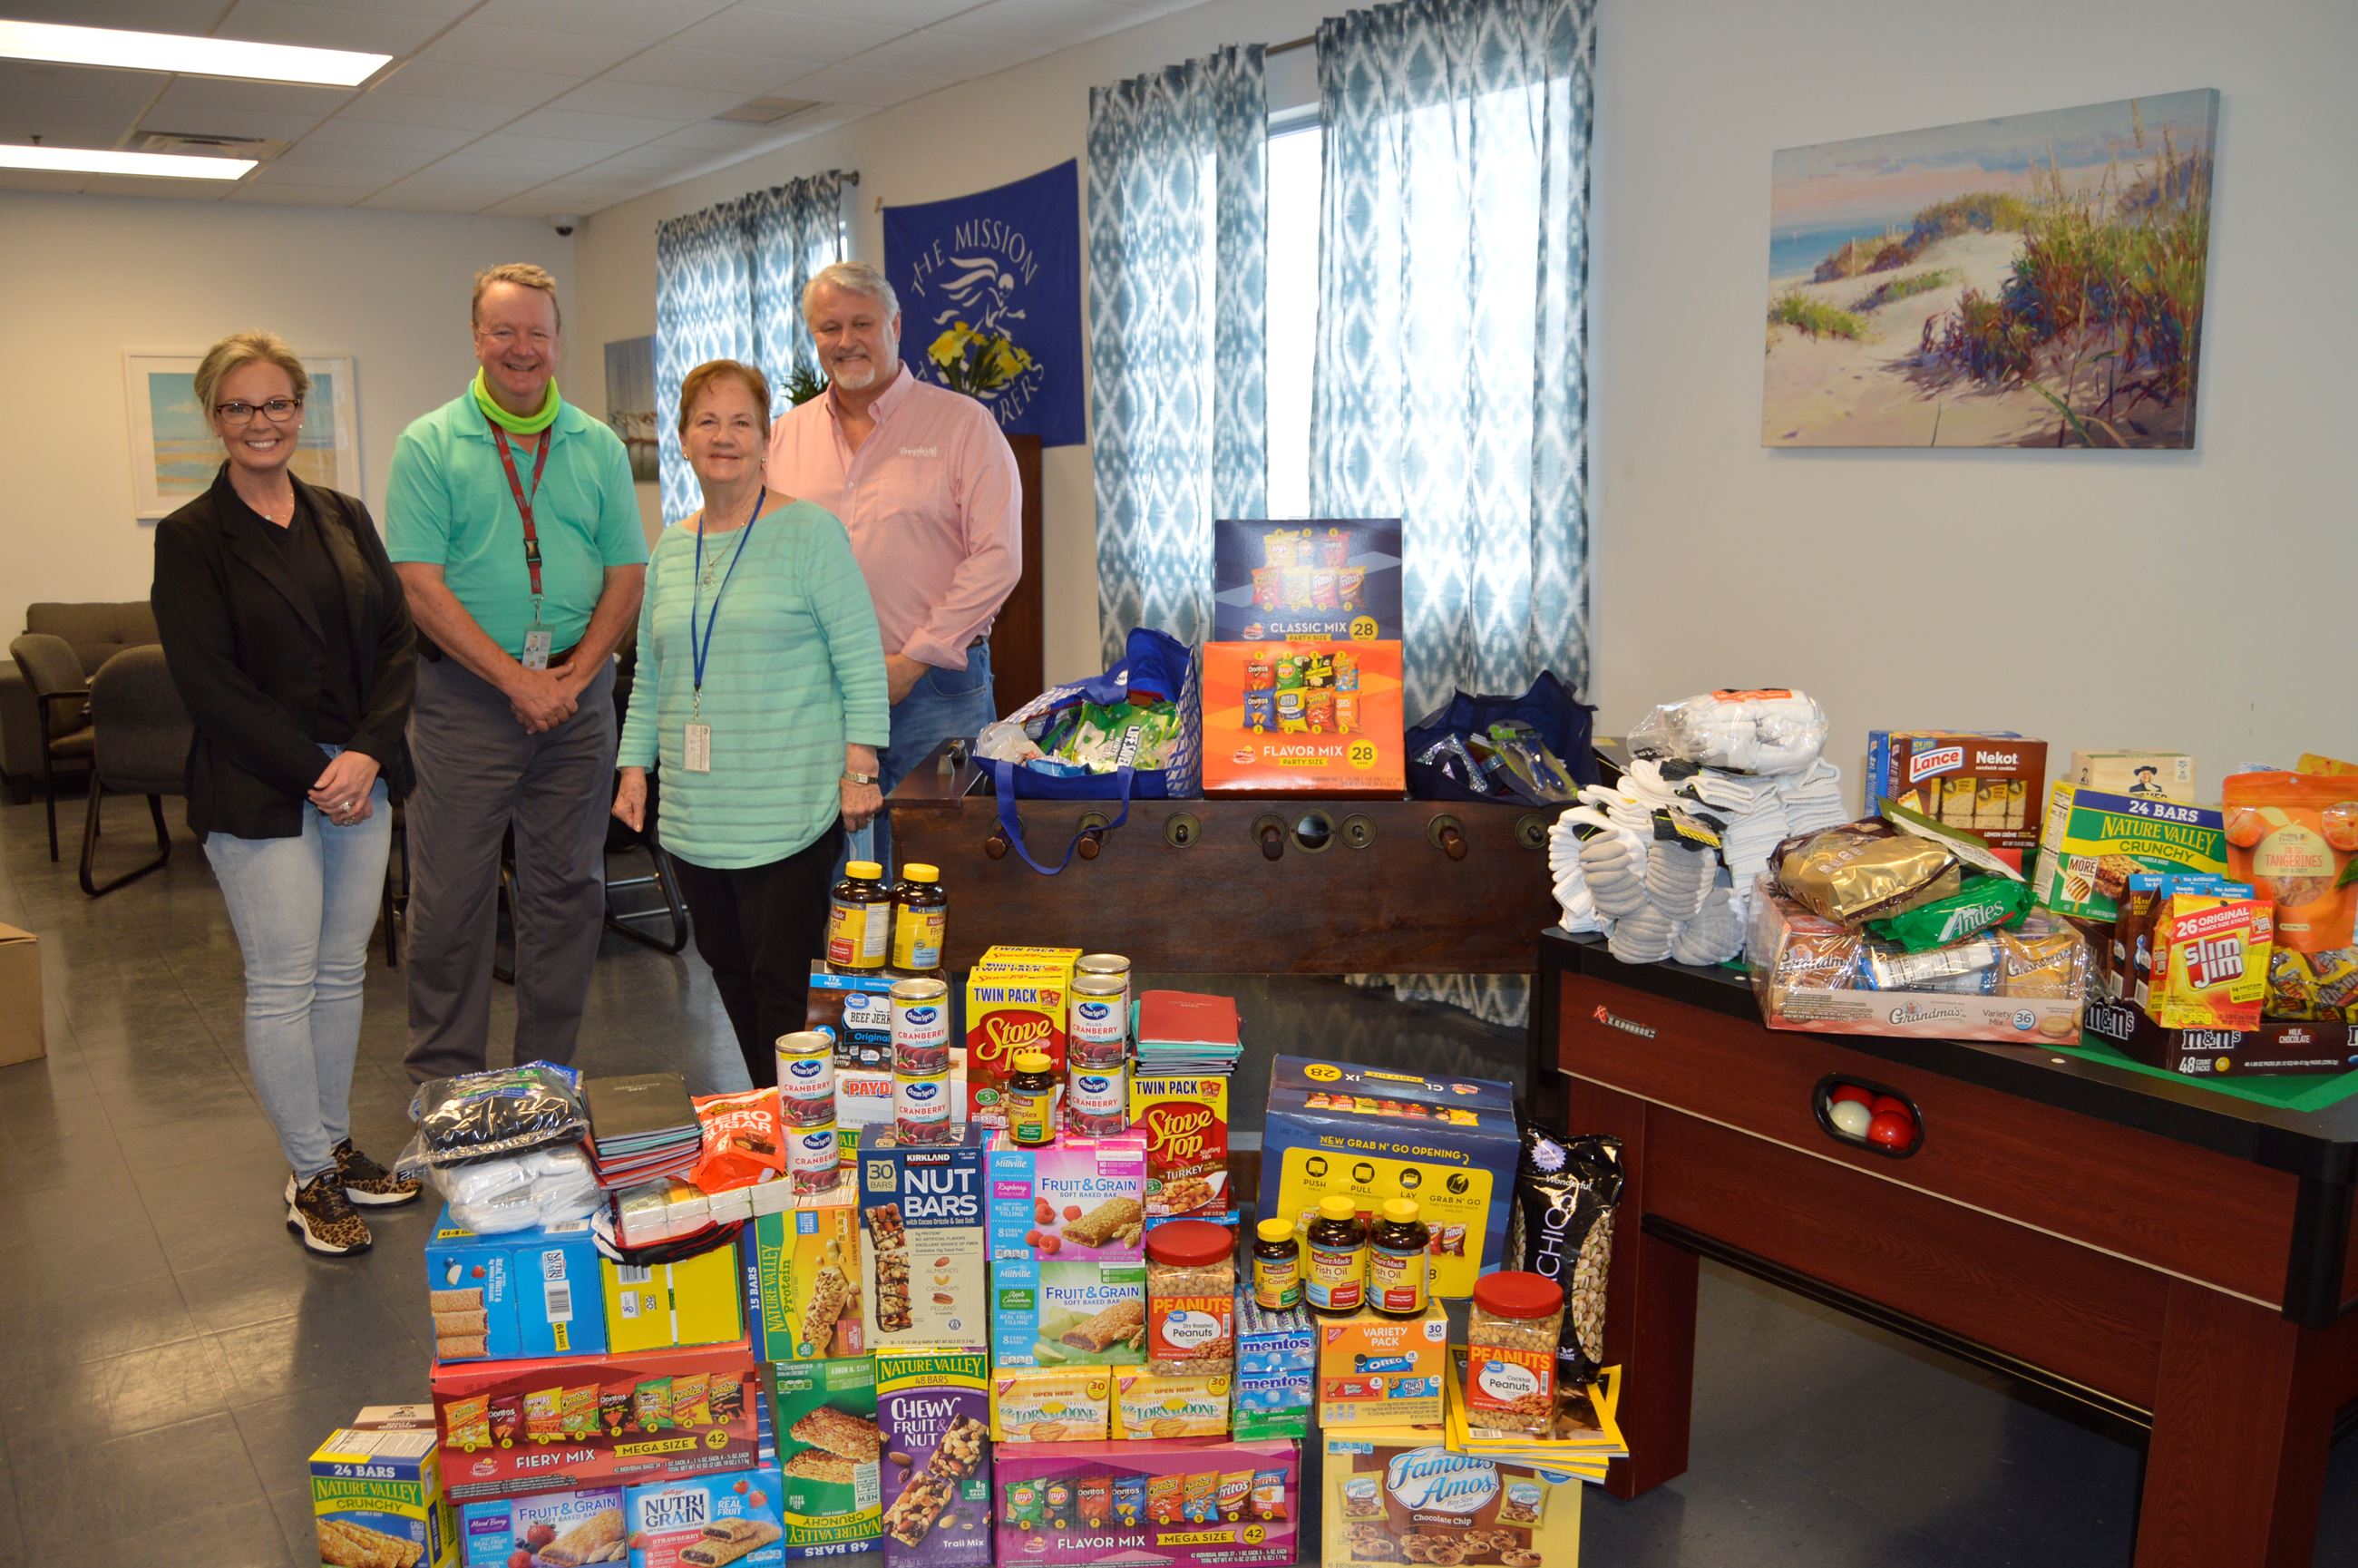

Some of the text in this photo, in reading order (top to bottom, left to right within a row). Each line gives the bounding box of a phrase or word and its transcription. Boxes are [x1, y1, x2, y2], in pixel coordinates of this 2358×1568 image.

[911, 218, 1039, 298] THE MISSION
[1270, 622, 1348, 633] CLASSIC MIX
[1353, 623, 1374, 637] 28
[1262, 745, 1343, 756] FLAVOR MIX
[1351, 746, 1373, 760] 28
[1975, 750, 2018, 765] Nekot
[1913, 750, 1960, 773] Lance
[2129, 800, 2198, 823] 24 BARS
[2100, 815, 2218, 856] NATURE VALLEY
[2119, 841, 2195, 862] CRUNCHY
[2069, 859, 2096, 873] MORE
[2265, 855, 2323, 868] TANGERINES
[1947, 901, 2004, 940] Andes
[2176, 907, 2250, 938] 26 ORIGINAL
[2184, 938, 2242, 967] slim
[2195, 955, 2244, 989] Jim
[973, 988, 1038, 1003] TWIN PACK
[850, 1013, 870, 1024] BEEF
[1889, 1006, 1962, 1026] Grandma's
[1983, 1008, 2012, 1019] Variety
[2015, 1012, 2032, 1024] 36
[1988, 1017, 2004, 1027] Mix
[898, 1028, 945, 1039] CRANBERRY
[1073, 1025, 1118, 1035] CRANBERRY
[2287, 1028, 2302, 1037] MILK
[854, 1033, 891, 1043] Original
[976, 1017, 1053, 1061] Stove
[2278, 1035, 2311, 1044] CHOCOLATE
[2179, 1057, 2195, 1073] 48
[784, 1080, 831, 1093] CRANBERRY
[1135, 1080, 1198, 1095] TWIN PACK
[899, 1103, 947, 1115] CRANBERRY
[1073, 1098, 1118, 1108] CRANBERRY
[702, 1110, 772, 1128] ZERO
[702, 1120, 772, 1143] SUGAR
[1147, 1109, 1213, 1152] Stove
[1163, 1136, 1203, 1162] Top
[1200, 1147, 1221, 1156] Stuffing
[1320, 1135, 1461, 1161] NEW GRAB N' GO OPENING
[795, 1152, 840, 1165] CRANBERRY
[907, 1154, 950, 1162] KIRKLAND
[995, 1159, 1027, 1168] Millville
[869, 1164, 893, 1179] 30
[1166, 1164, 1203, 1180] TURKEY
[870, 1181, 893, 1189] BARS
[904, 1169, 976, 1194] NUT
[997, 1183, 1027, 1193] Raspberry
[1042, 1177, 1137, 1192] FRUIT & GRAIN
[1303, 1178, 1327, 1188] PUSH
[1546, 1175, 1593, 1192] Wonderful
[1350, 1184, 1372, 1194] PULL
[1400, 1191, 1417, 1200] LAY
[905, 1195, 978, 1217] BARS
[1429, 1195, 1481, 1206] GRAB N' GO
[1000, 1269, 1032, 1279] Millville
[1315, 1265, 1348, 1275] Fish Oil
[779, 1259, 794, 1314] Protein
[1261, 1276, 1297, 1285] B-Complex
[748, 1266, 761, 1310] 15 BARS
[762, 1243, 786, 1334] NATURE VALLEY
[1046, 1285, 1139, 1300] FRUIT & GRAIN
[1153, 1298, 1232, 1313] PEANUTS
[1173, 1329, 1213, 1337] Peanuts
[1363, 1327, 1408, 1337] VARIETY
[1428, 1324, 1442, 1333] 30
[1242, 1338, 1310, 1351] mentos
[1371, 1337, 1398, 1346] PACK
[1369, 1358, 1402, 1369] OREO
[1470, 1346, 1551, 1370] PEANUTS
[881, 1357, 983, 1381] NATURE VALLEY
[915, 1375, 949, 1385] 48 BARS
[1211, 1378, 1226, 1387] 30
[1242, 1378, 1309, 1390] mentos
[1489, 1378, 1530, 1392] Peanuts
[1506, 1374, 1531, 1382] Cocktail
[1090, 1381, 1106, 1390] 30
[891, 1397, 961, 1420] CHEWY
[893, 1418, 948, 1434] FRUIT &
[708, 1432, 726, 1444] 42
[904, 1433, 939, 1446] NUT
[622, 1440, 689, 1455] MEGA SIZE
[516, 1448, 596, 1468] FIERY MIX
[334, 1464, 395, 1477] 24 BARS
[1388, 1451, 1495, 1490] Famous
[1253, 1476, 1280, 1485] RUFFLES
[317, 1479, 418, 1504] NATURE VALLEY
[1112, 1487, 1140, 1496] Doritos
[1410, 1475, 1499, 1509] Amos
[336, 1498, 403, 1512] CRUNCHY
[519, 1497, 617, 1521] FRUIT & GRAIN
[645, 1495, 705, 1513] NUTRI
[645, 1512, 705, 1528] GRAIN
[803, 1512, 865, 1526] CRUNCHY
[1413, 1514, 1472, 1526] Chocolate Chip
[1164, 1533, 1228, 1544] MEGA SIZE
[1246, 1529, 1262, 1539] 42
[942, 1538, 984, 1547] Trail Mix
[1057, 1534, 1145, 1550] FLAVOR MIX
[804, 1542, 869, 1557] 48 BARS
